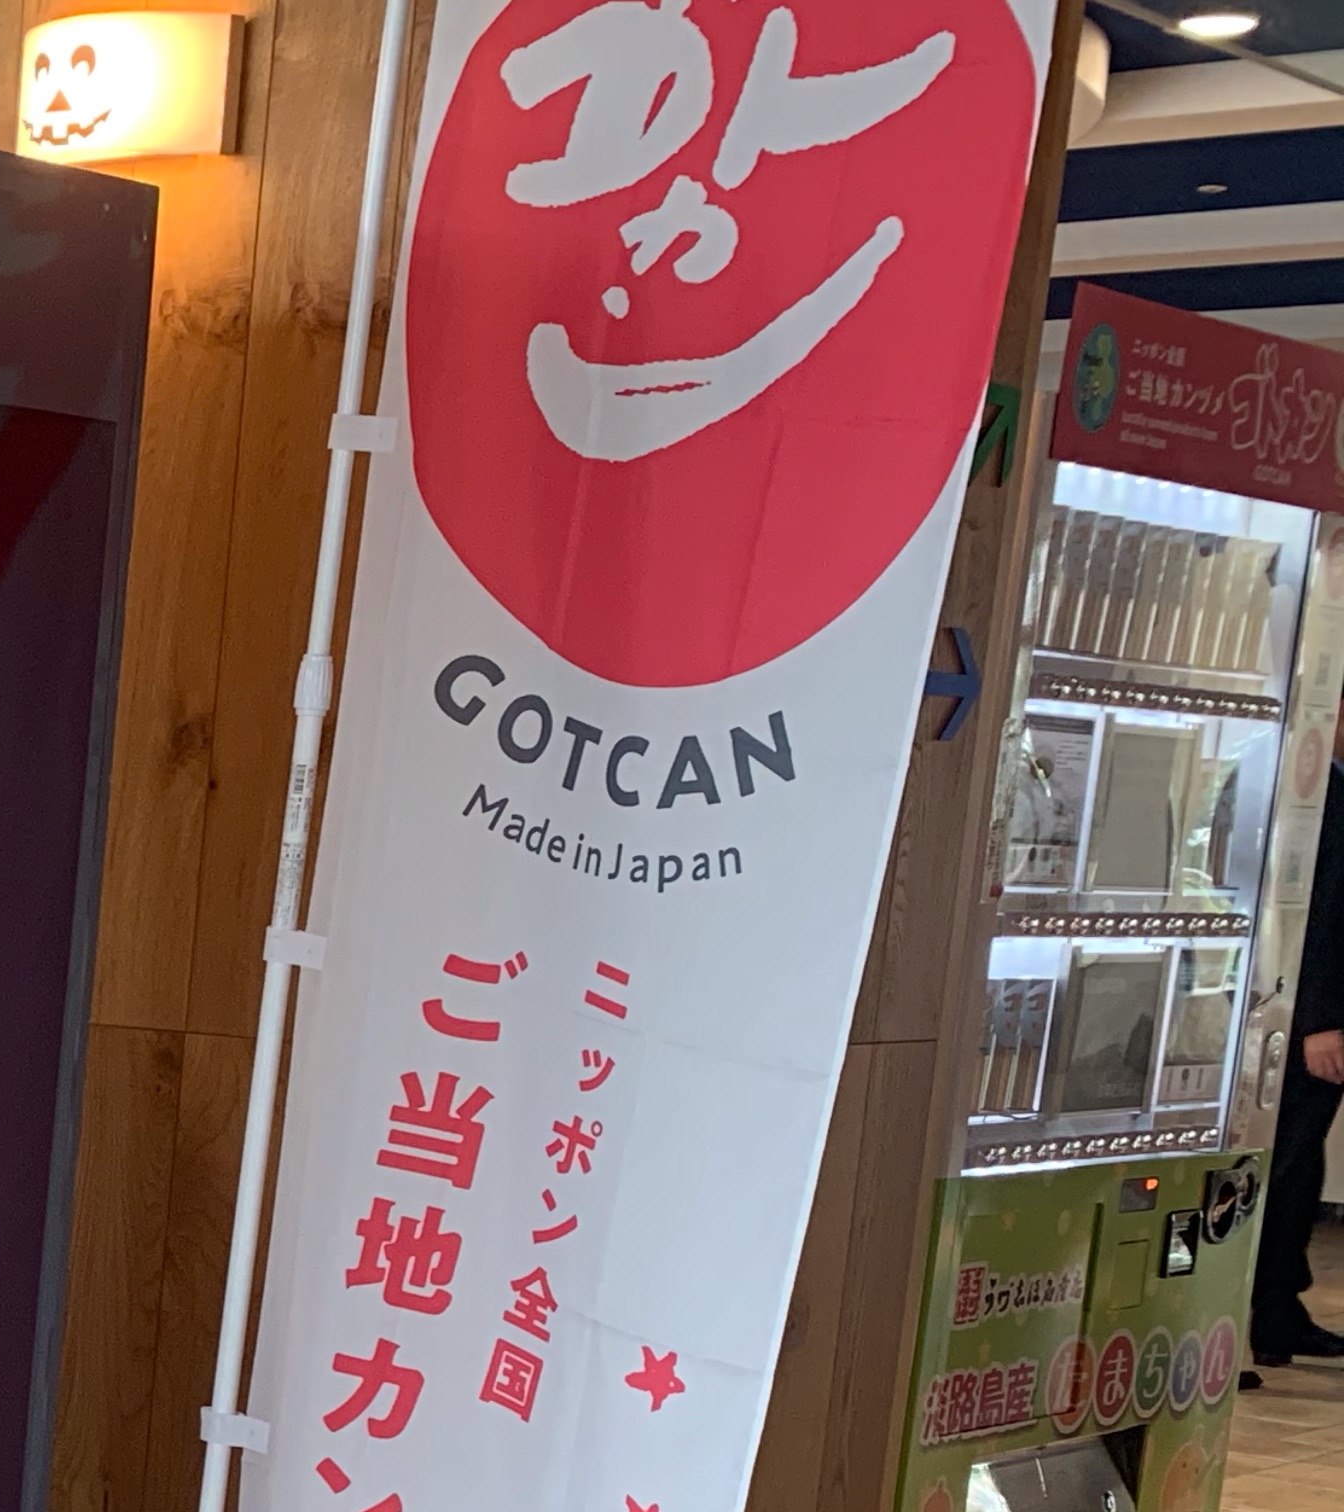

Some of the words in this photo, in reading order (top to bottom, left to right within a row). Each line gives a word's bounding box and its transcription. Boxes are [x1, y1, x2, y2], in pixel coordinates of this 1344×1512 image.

[434, 654, 796, 810] GOTCAN
[478, 960, 631, 1424] ニッポン全国
